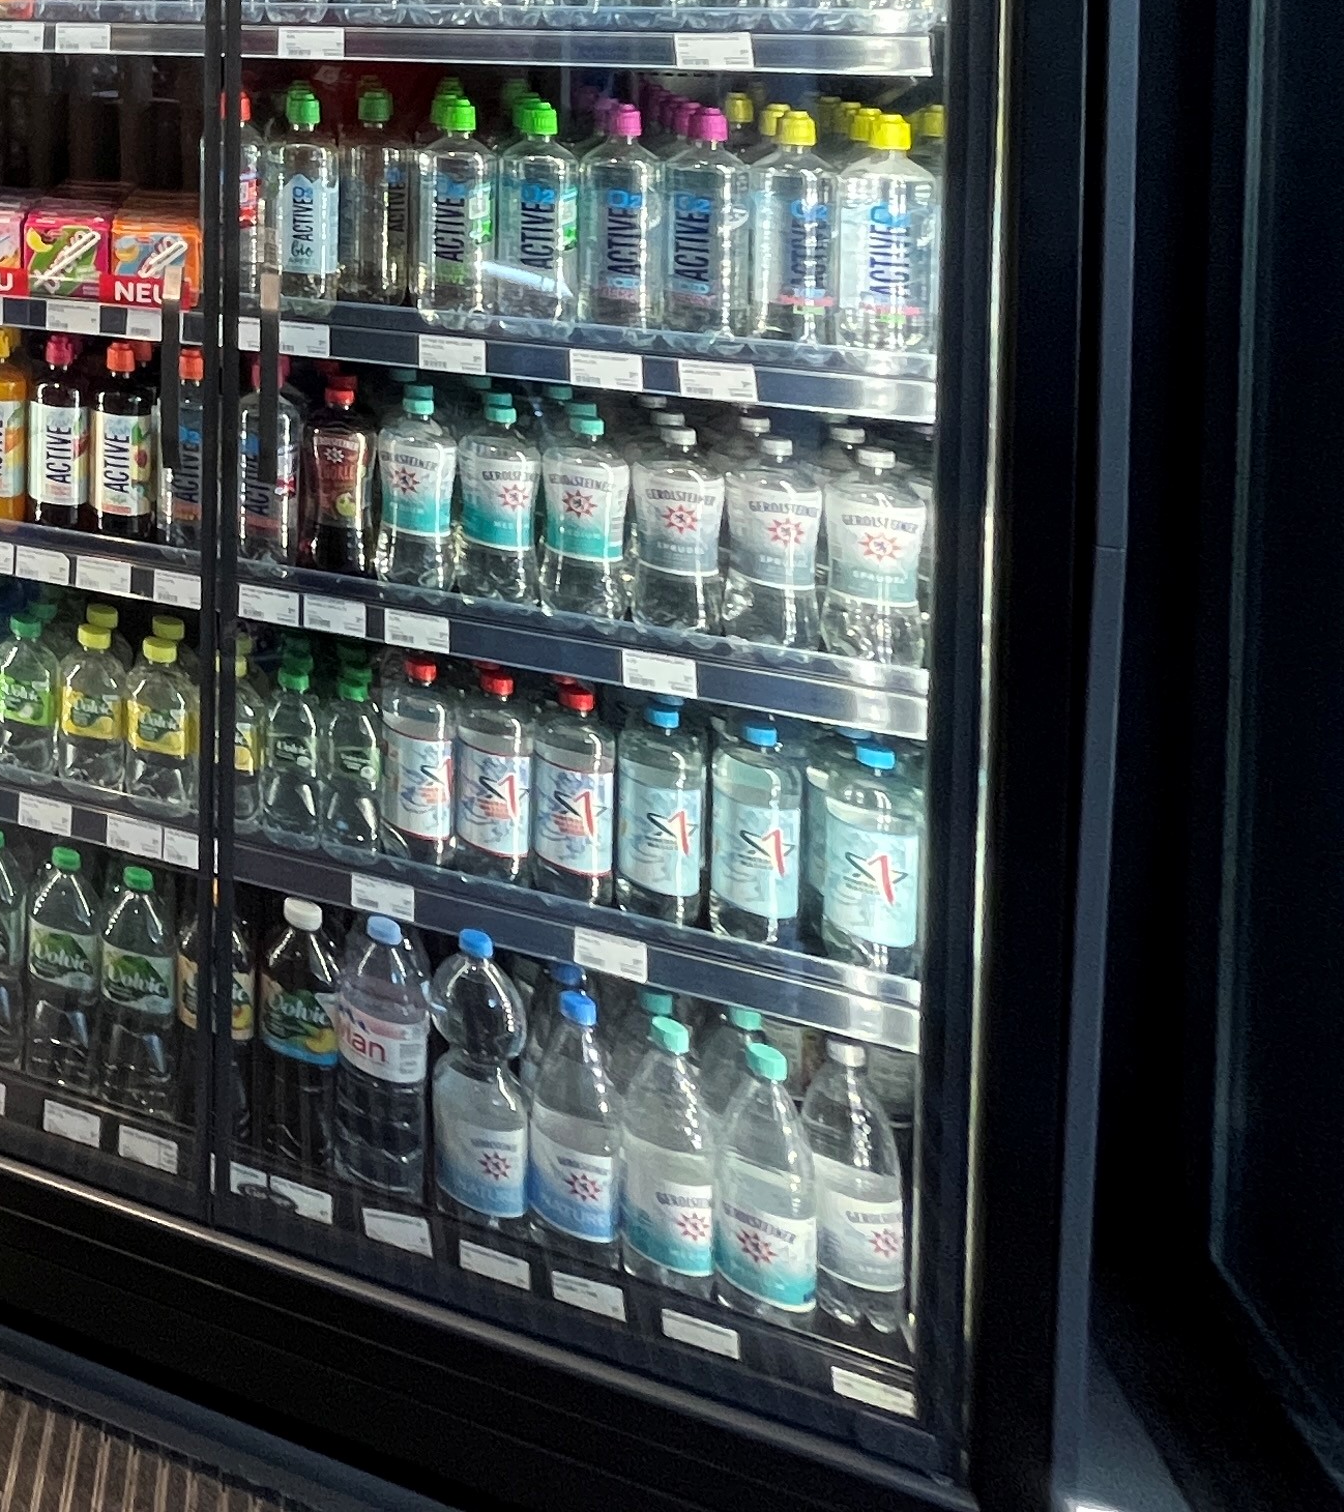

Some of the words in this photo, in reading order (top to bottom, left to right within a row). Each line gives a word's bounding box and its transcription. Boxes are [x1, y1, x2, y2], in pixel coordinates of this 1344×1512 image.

[520, 201, 555, 270] ACTIVE
[606, 206, 641, 276] ACTIVE
[673, 209, 711, 283] ACTIVE
[46, 424, 72, 485] ACTIVE
[103, 432, 130, 494] ACTIVE
